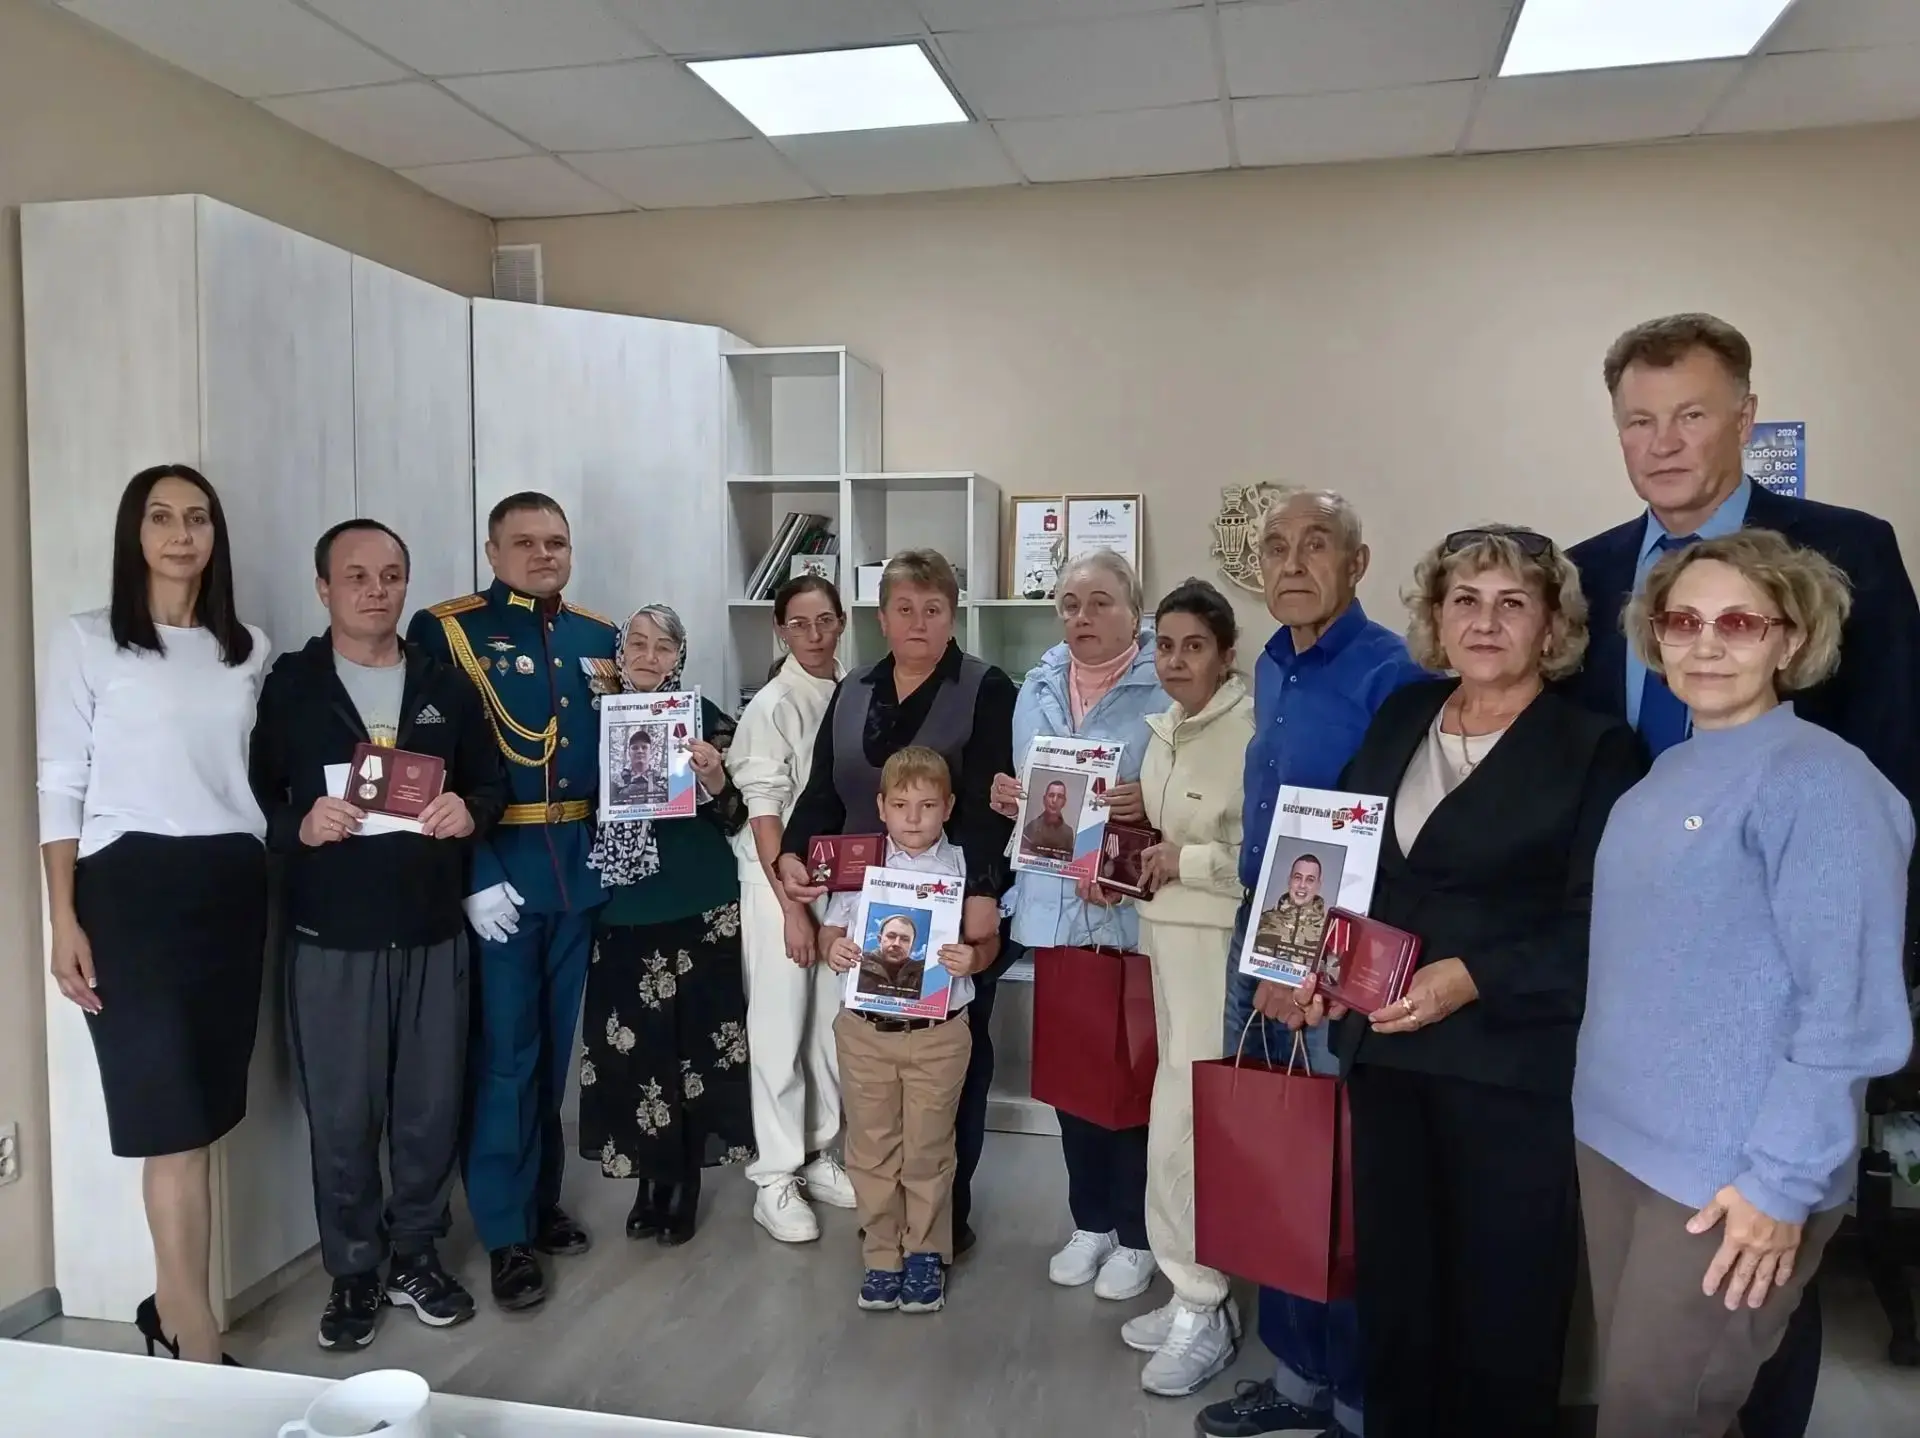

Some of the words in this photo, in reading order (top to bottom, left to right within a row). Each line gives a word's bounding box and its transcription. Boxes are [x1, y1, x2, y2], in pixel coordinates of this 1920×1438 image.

[1777, 429, 1797, 437] 2026
[1764, 463, 1772, 471] о
[1775, 461, 1797, 471] Вас
[1035, 745, 1076, 756] БЕССМЕРТНЫЙ
[1282, 803, 1332, 818] БЕССМЕРТНЫЙ
[870, 878, 915, 891] БЕССМЕРТНЫЙ
